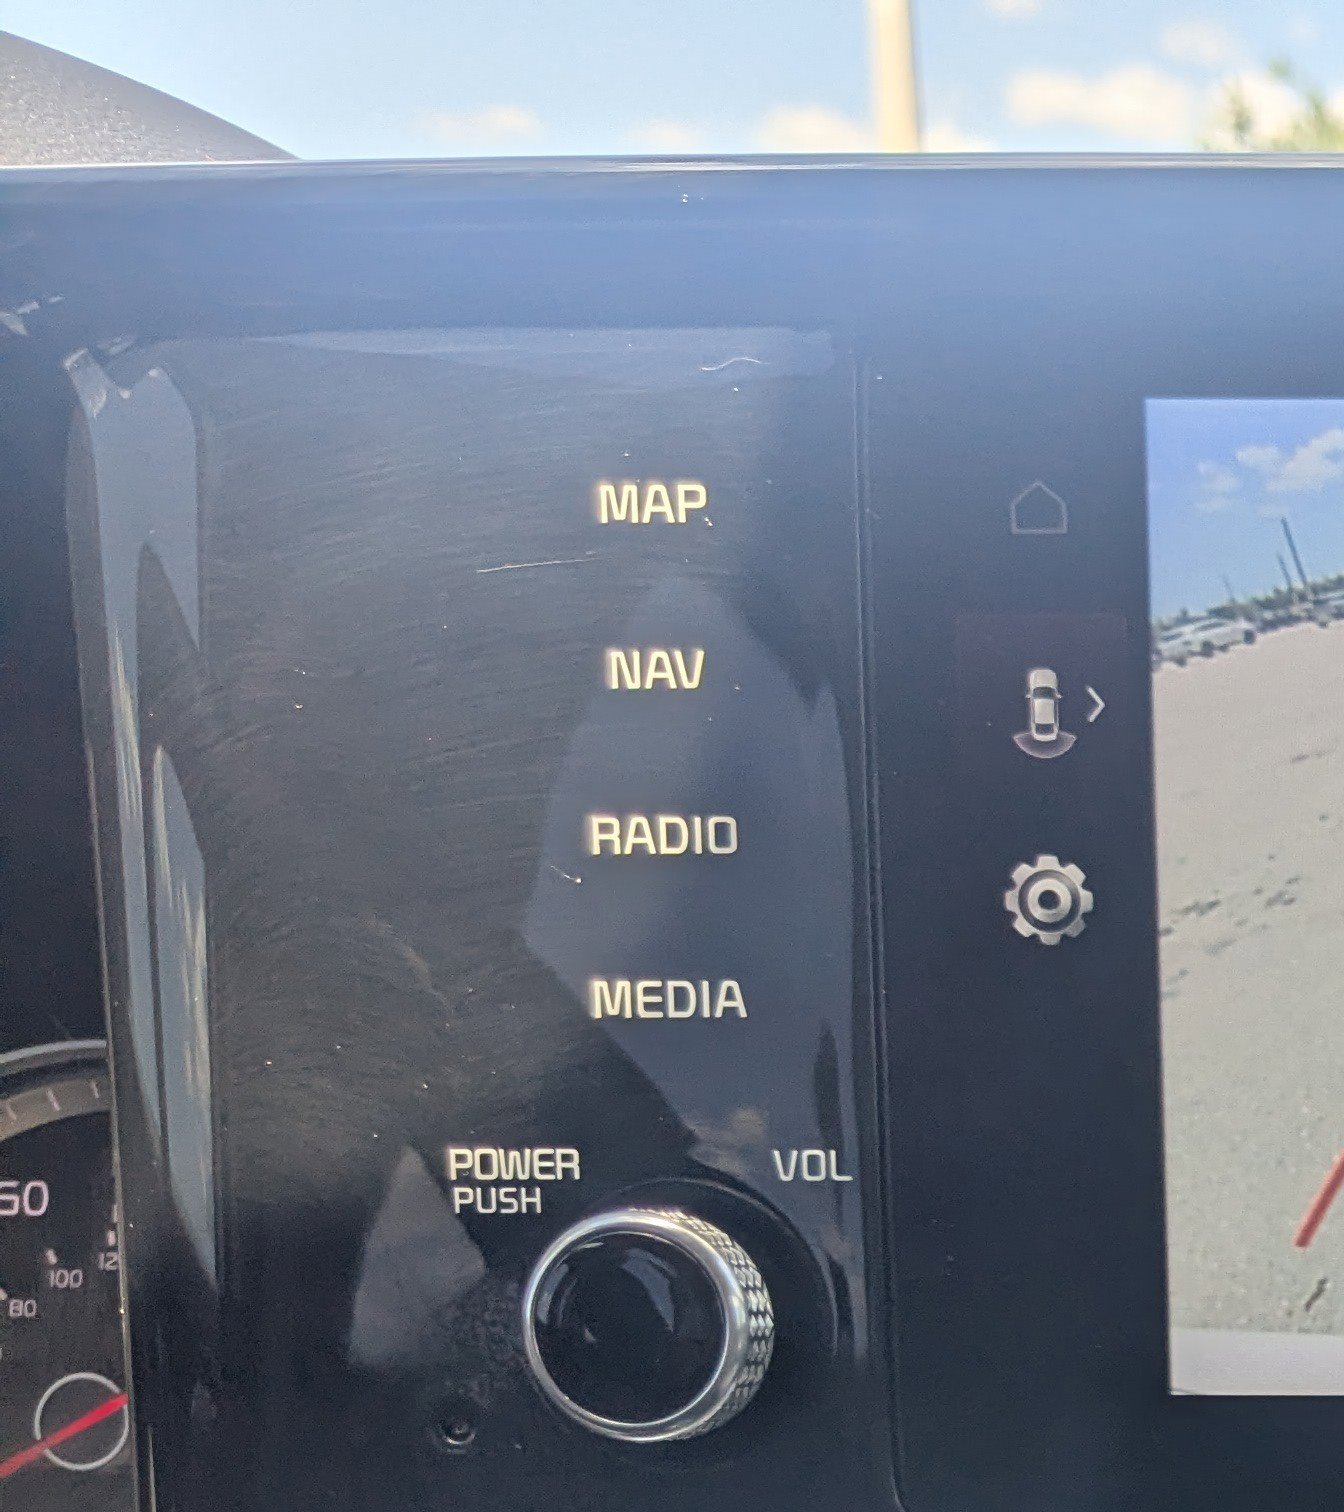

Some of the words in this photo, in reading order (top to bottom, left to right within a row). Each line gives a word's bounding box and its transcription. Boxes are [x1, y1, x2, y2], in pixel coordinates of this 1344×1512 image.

[597, 482, 707, 524] MAP
[606, 648, 705, 690] NAV
[588, 814, 738, 856] RADIO
[590, 977, 748, 1020] MEDIA
[447, 1146, 581, 1181] POWER
[772, 1149, 853, 1182] VOL
[452, 1186, 543, 1214] PUSH
[50, 1268, 84, 1289] 100
[8, 1299, 37, 1318] 80
